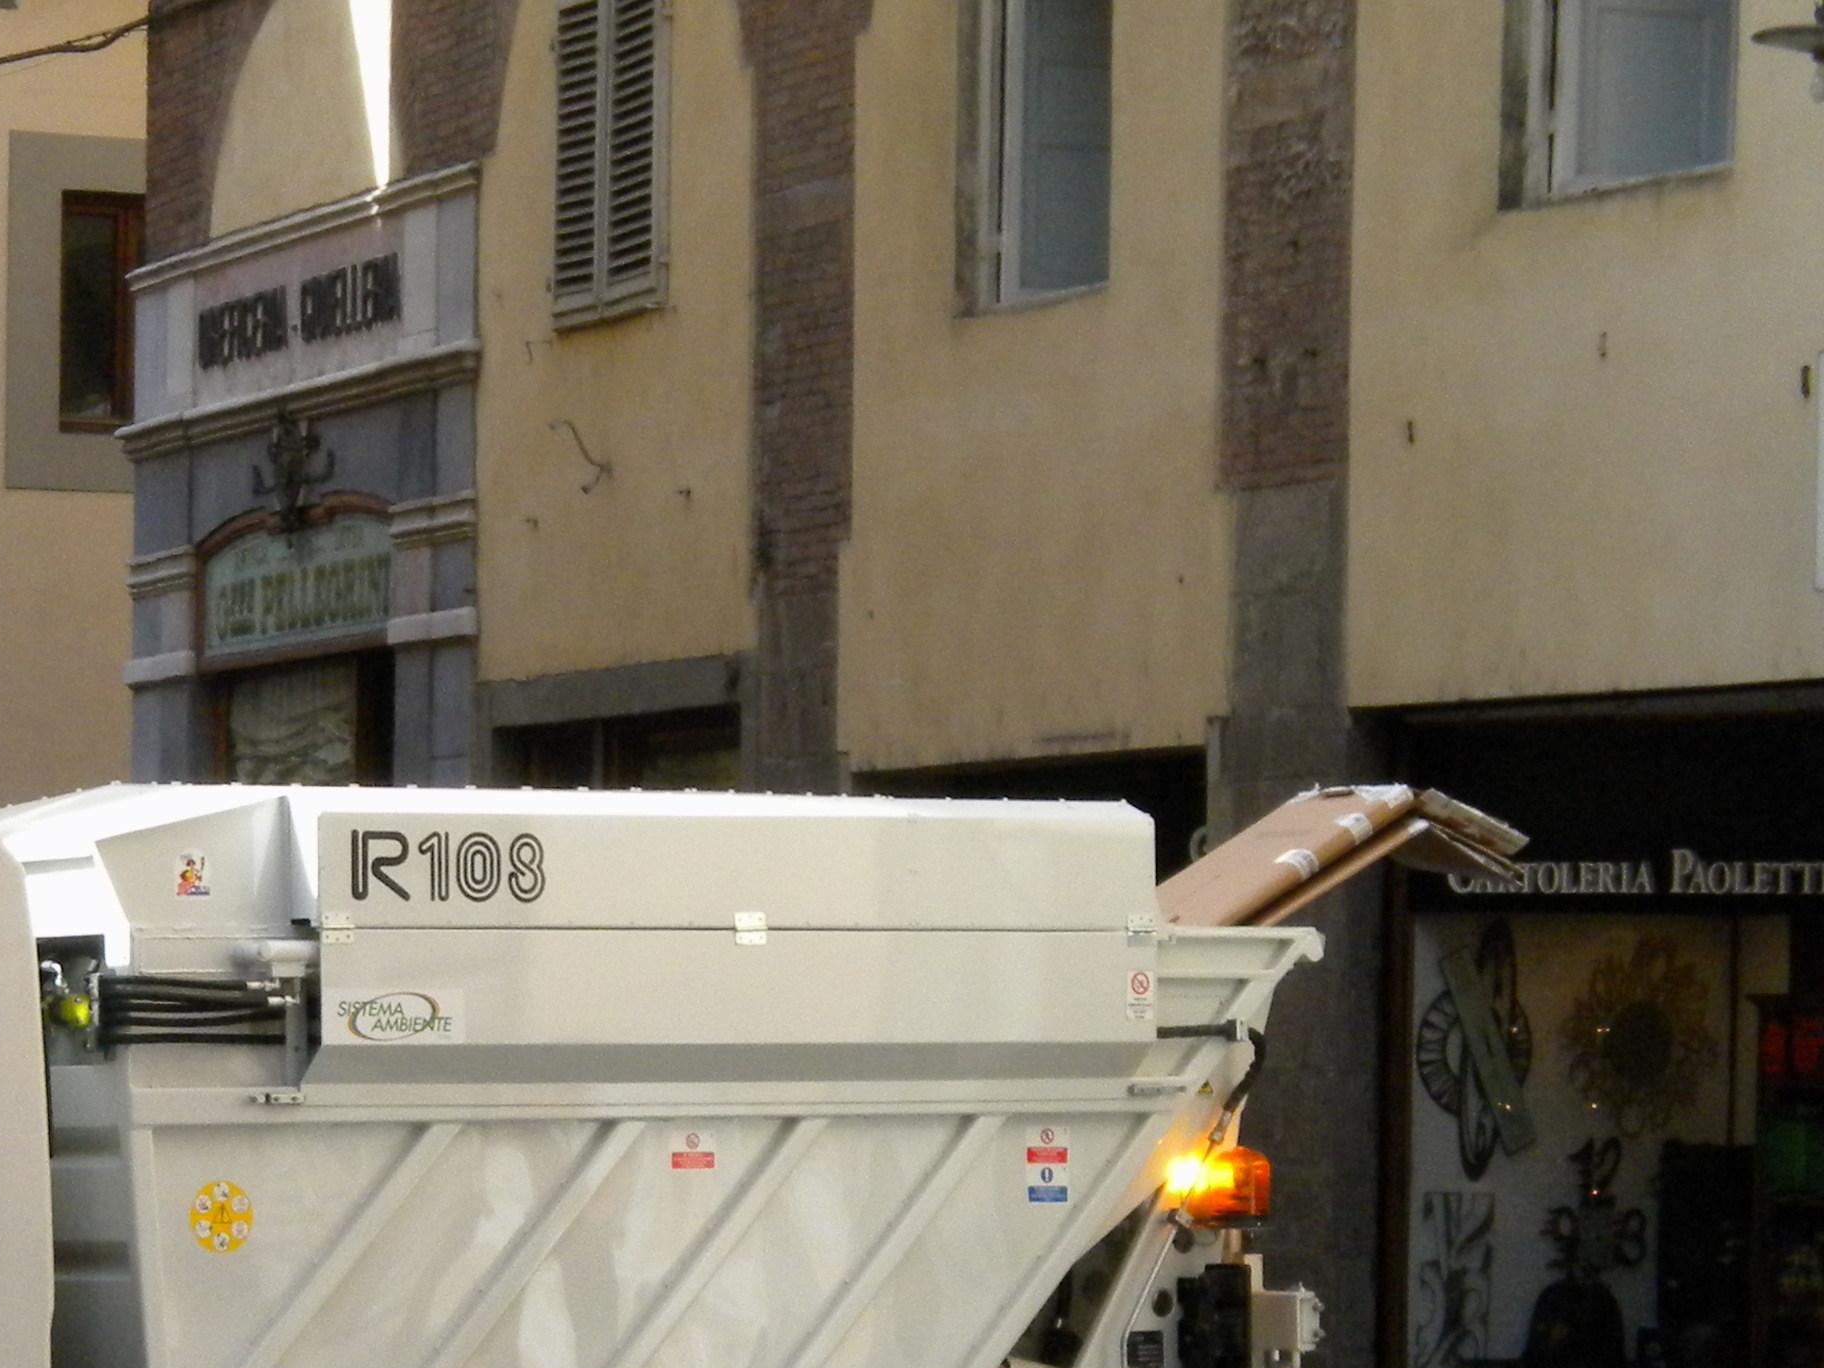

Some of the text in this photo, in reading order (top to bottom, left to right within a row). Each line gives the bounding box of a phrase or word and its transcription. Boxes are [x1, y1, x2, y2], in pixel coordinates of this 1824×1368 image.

[351, 829, 546, 903] R108
[337, 1001, 404, 1017] SISTEMA
[371, 1016, 453, 1032] AMBIENTE
